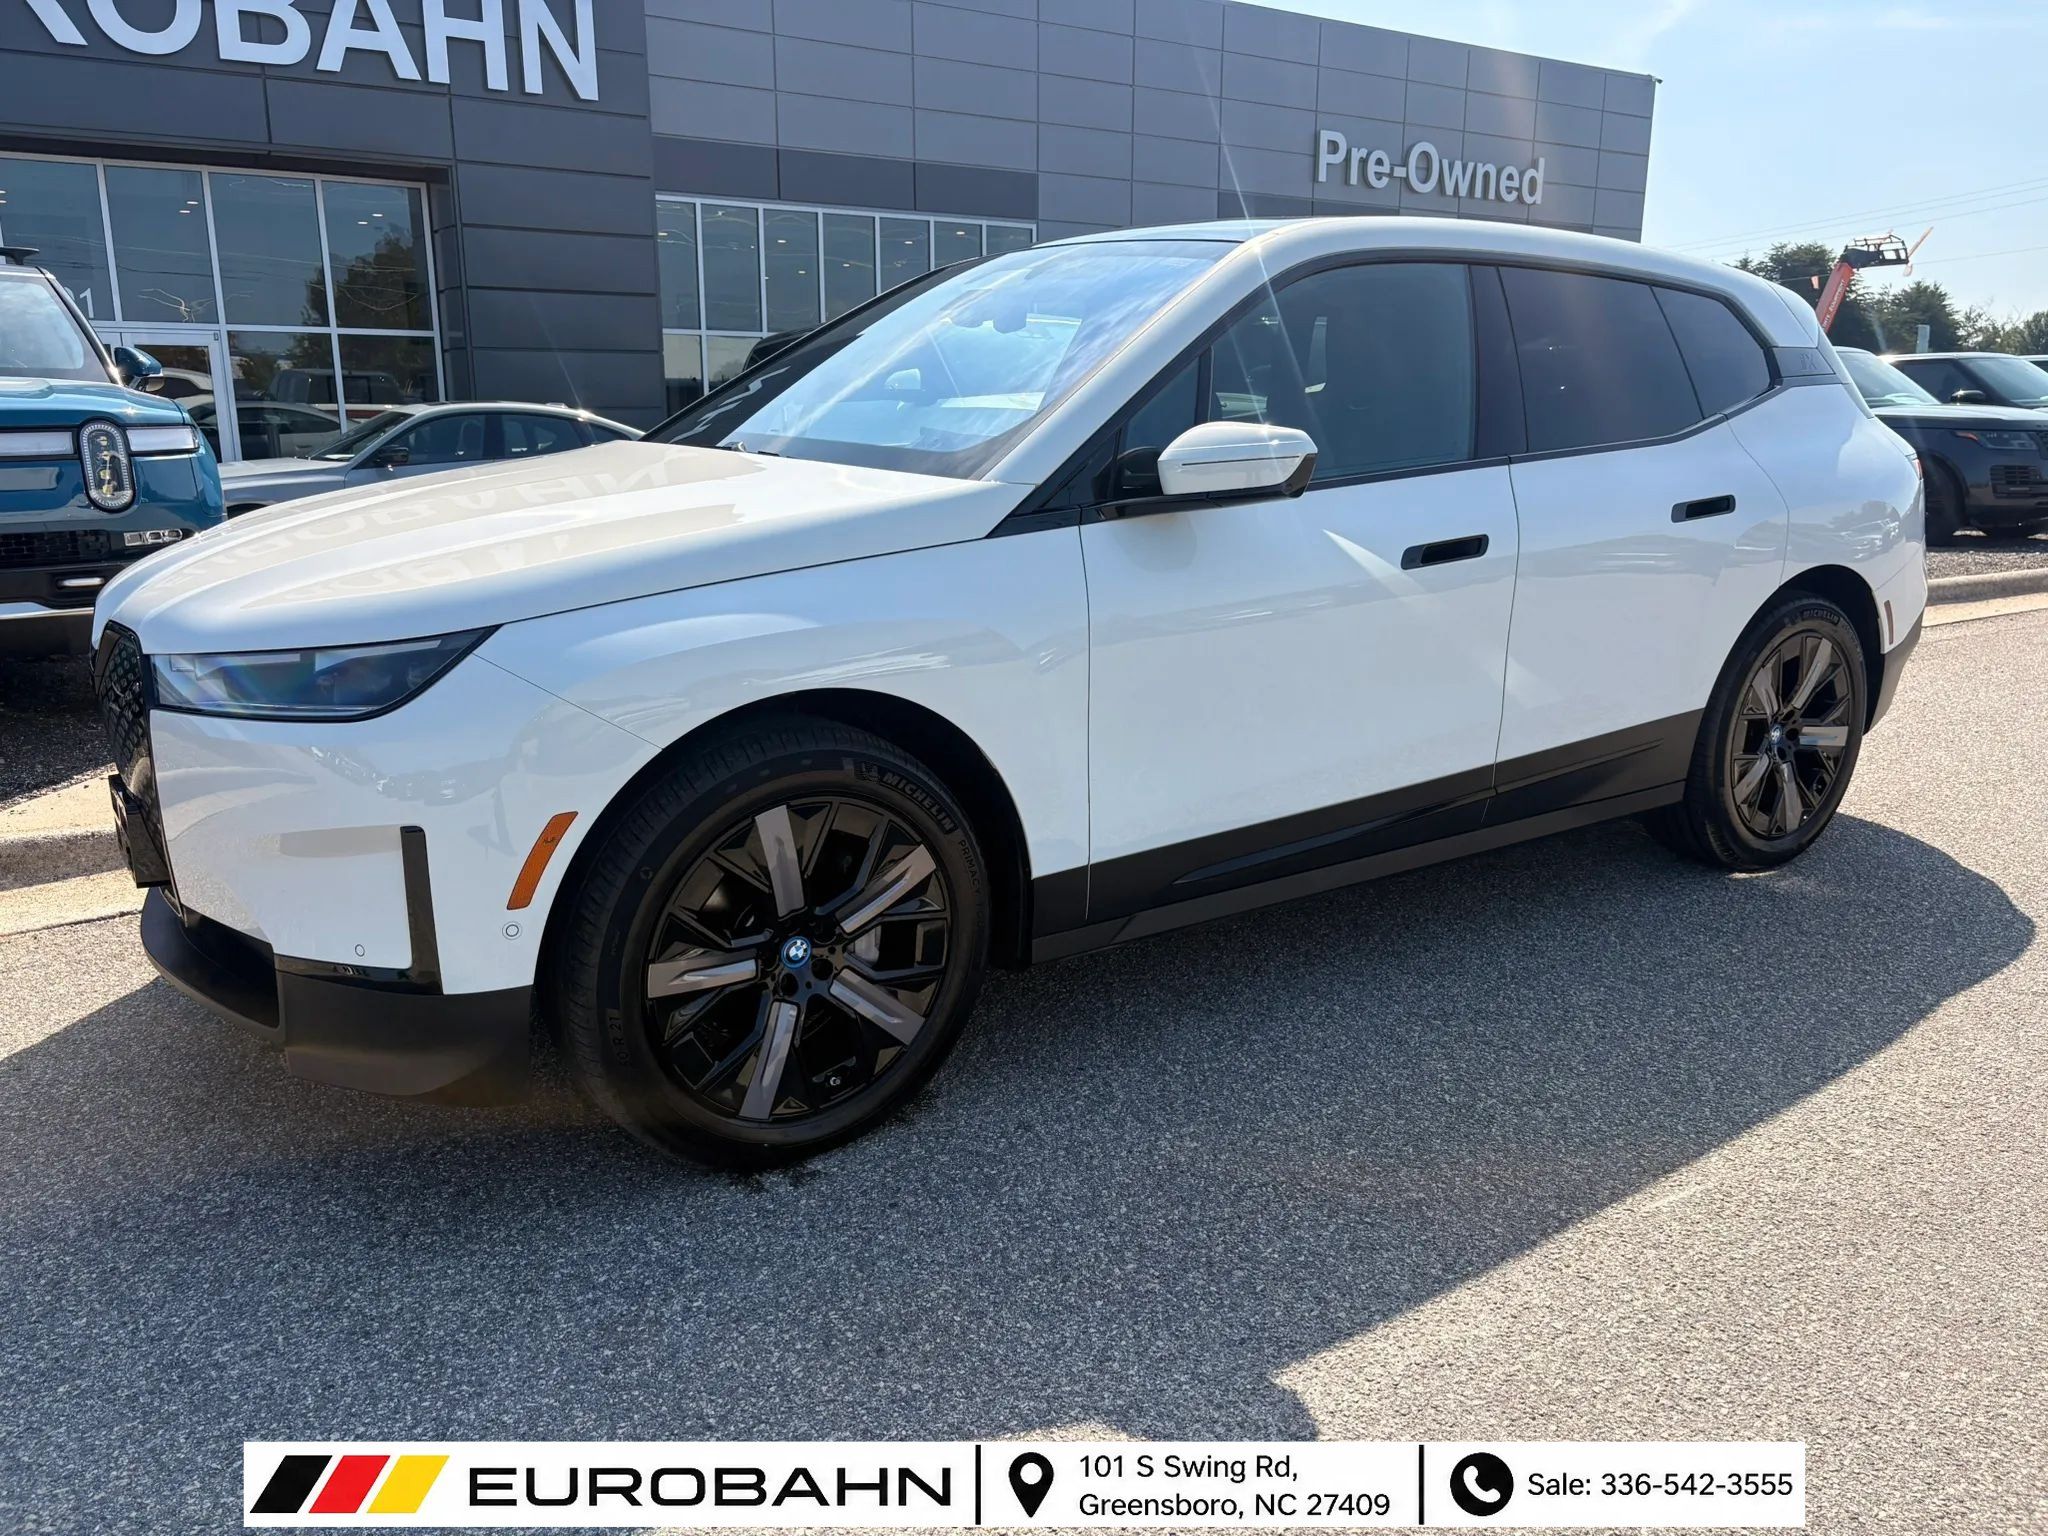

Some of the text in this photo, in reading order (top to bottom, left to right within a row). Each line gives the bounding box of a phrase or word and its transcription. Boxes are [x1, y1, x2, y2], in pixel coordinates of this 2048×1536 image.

[1317, 129, 1546, 206] Pre-Owned
[881, 770, 956, 832] MICHELIN
[957, 839, 983, 895] PRIMACY
